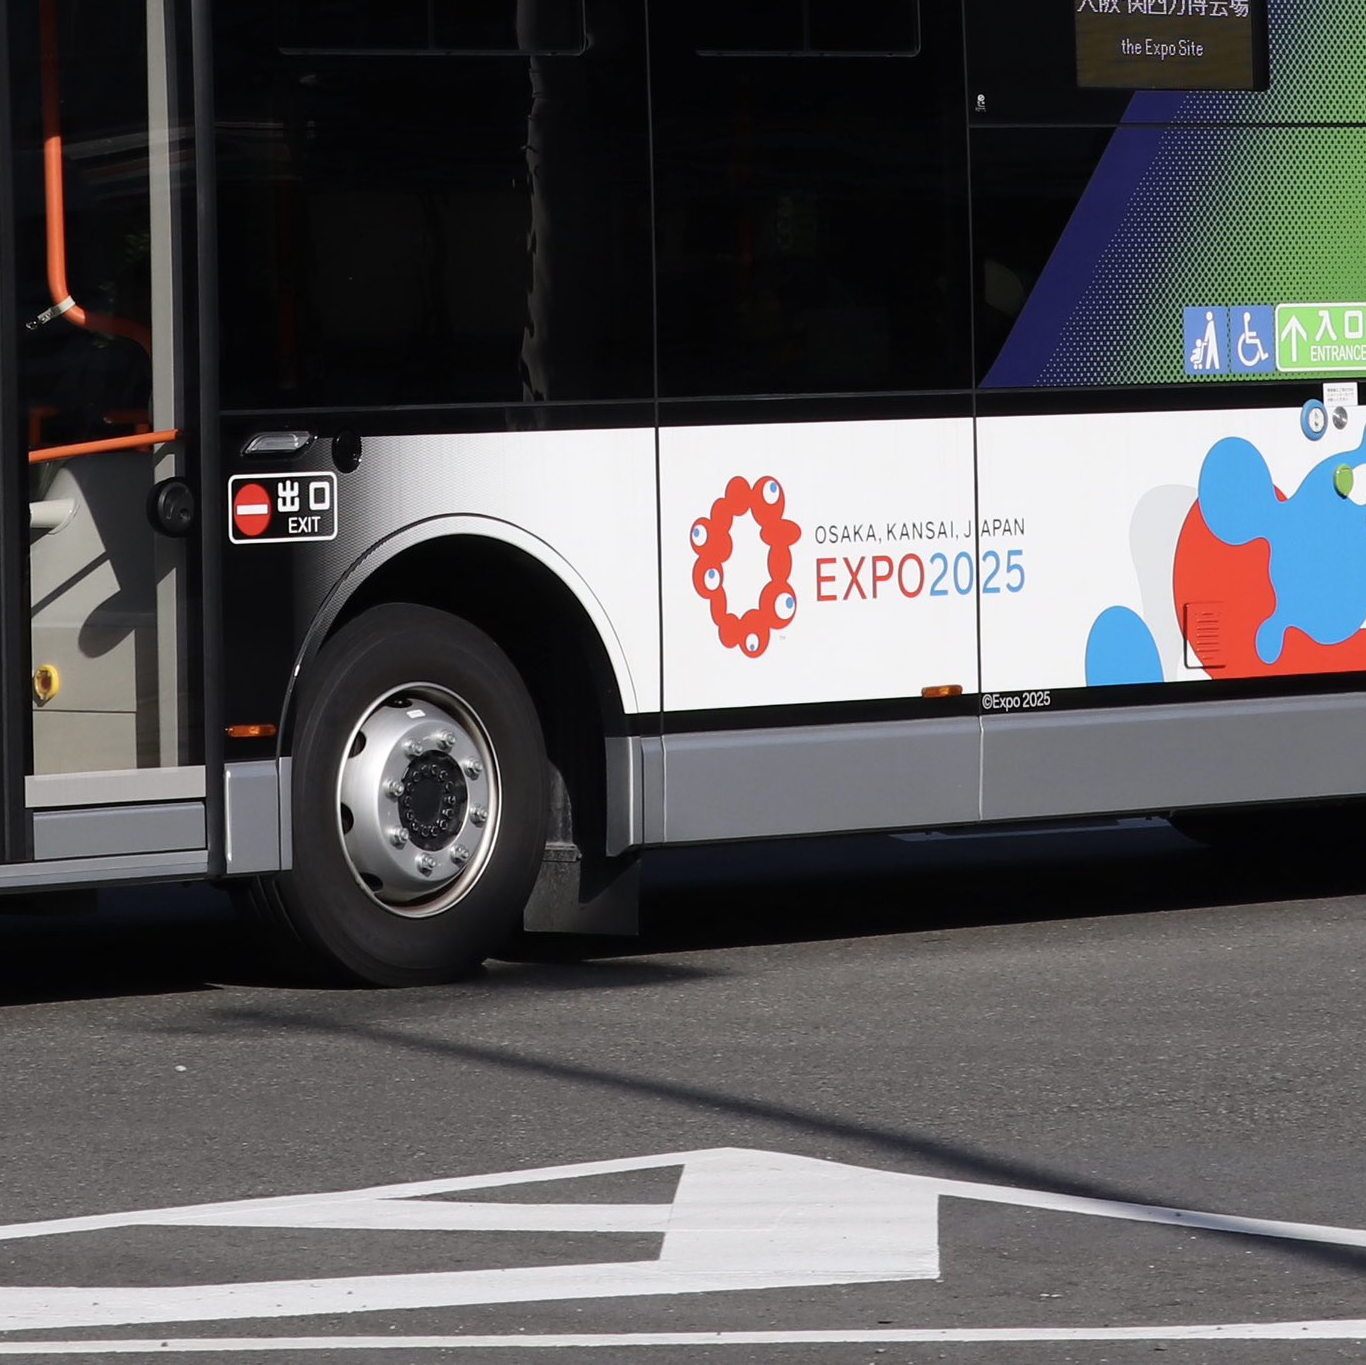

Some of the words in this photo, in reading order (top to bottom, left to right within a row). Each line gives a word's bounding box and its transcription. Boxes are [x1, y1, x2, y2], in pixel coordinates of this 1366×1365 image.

[1121, 38, 1142, 56] the
[1145, 38, 1177, 61] Expo
[1178, 39, 1204, 57] Site
[1315, 310, 1363, 342] 入口
[277, 480, 331, 513] 出口
[288, 516, 321, 534] EXIT
[815, 524, 883, 545] OSAKA,
[886, 520, 959, 540] KANSAI,
[963, 518, 1025, 539] JAPAN
[1022, 690, 1051, 708] 2025
